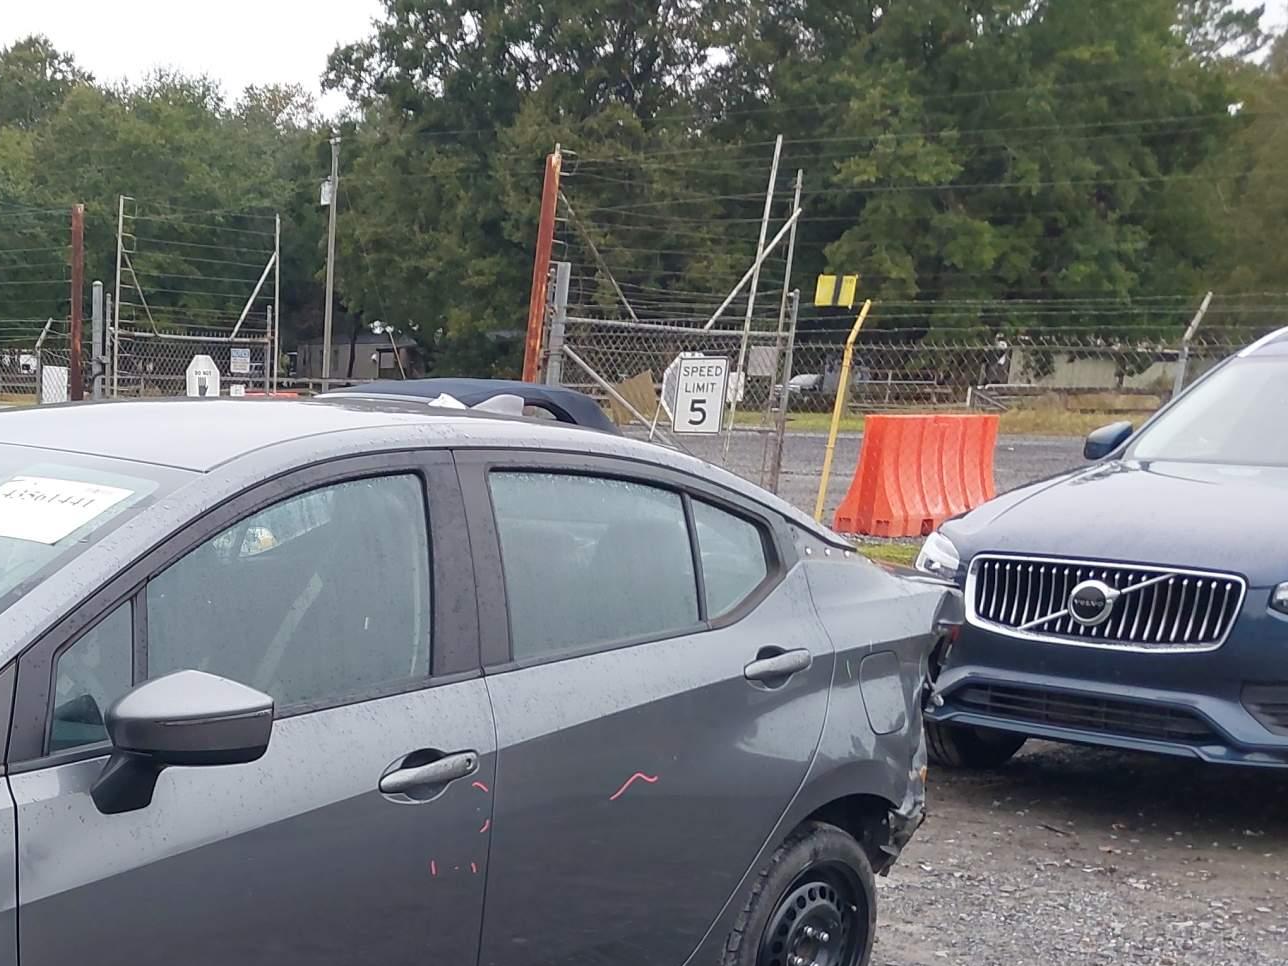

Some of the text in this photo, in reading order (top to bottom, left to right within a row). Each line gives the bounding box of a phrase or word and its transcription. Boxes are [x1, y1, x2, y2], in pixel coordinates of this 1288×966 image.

[683, 366, 723, 377] SPEED
[685, 382, 717, 393] LIMIT
[688, 399, 707, 426] 5
